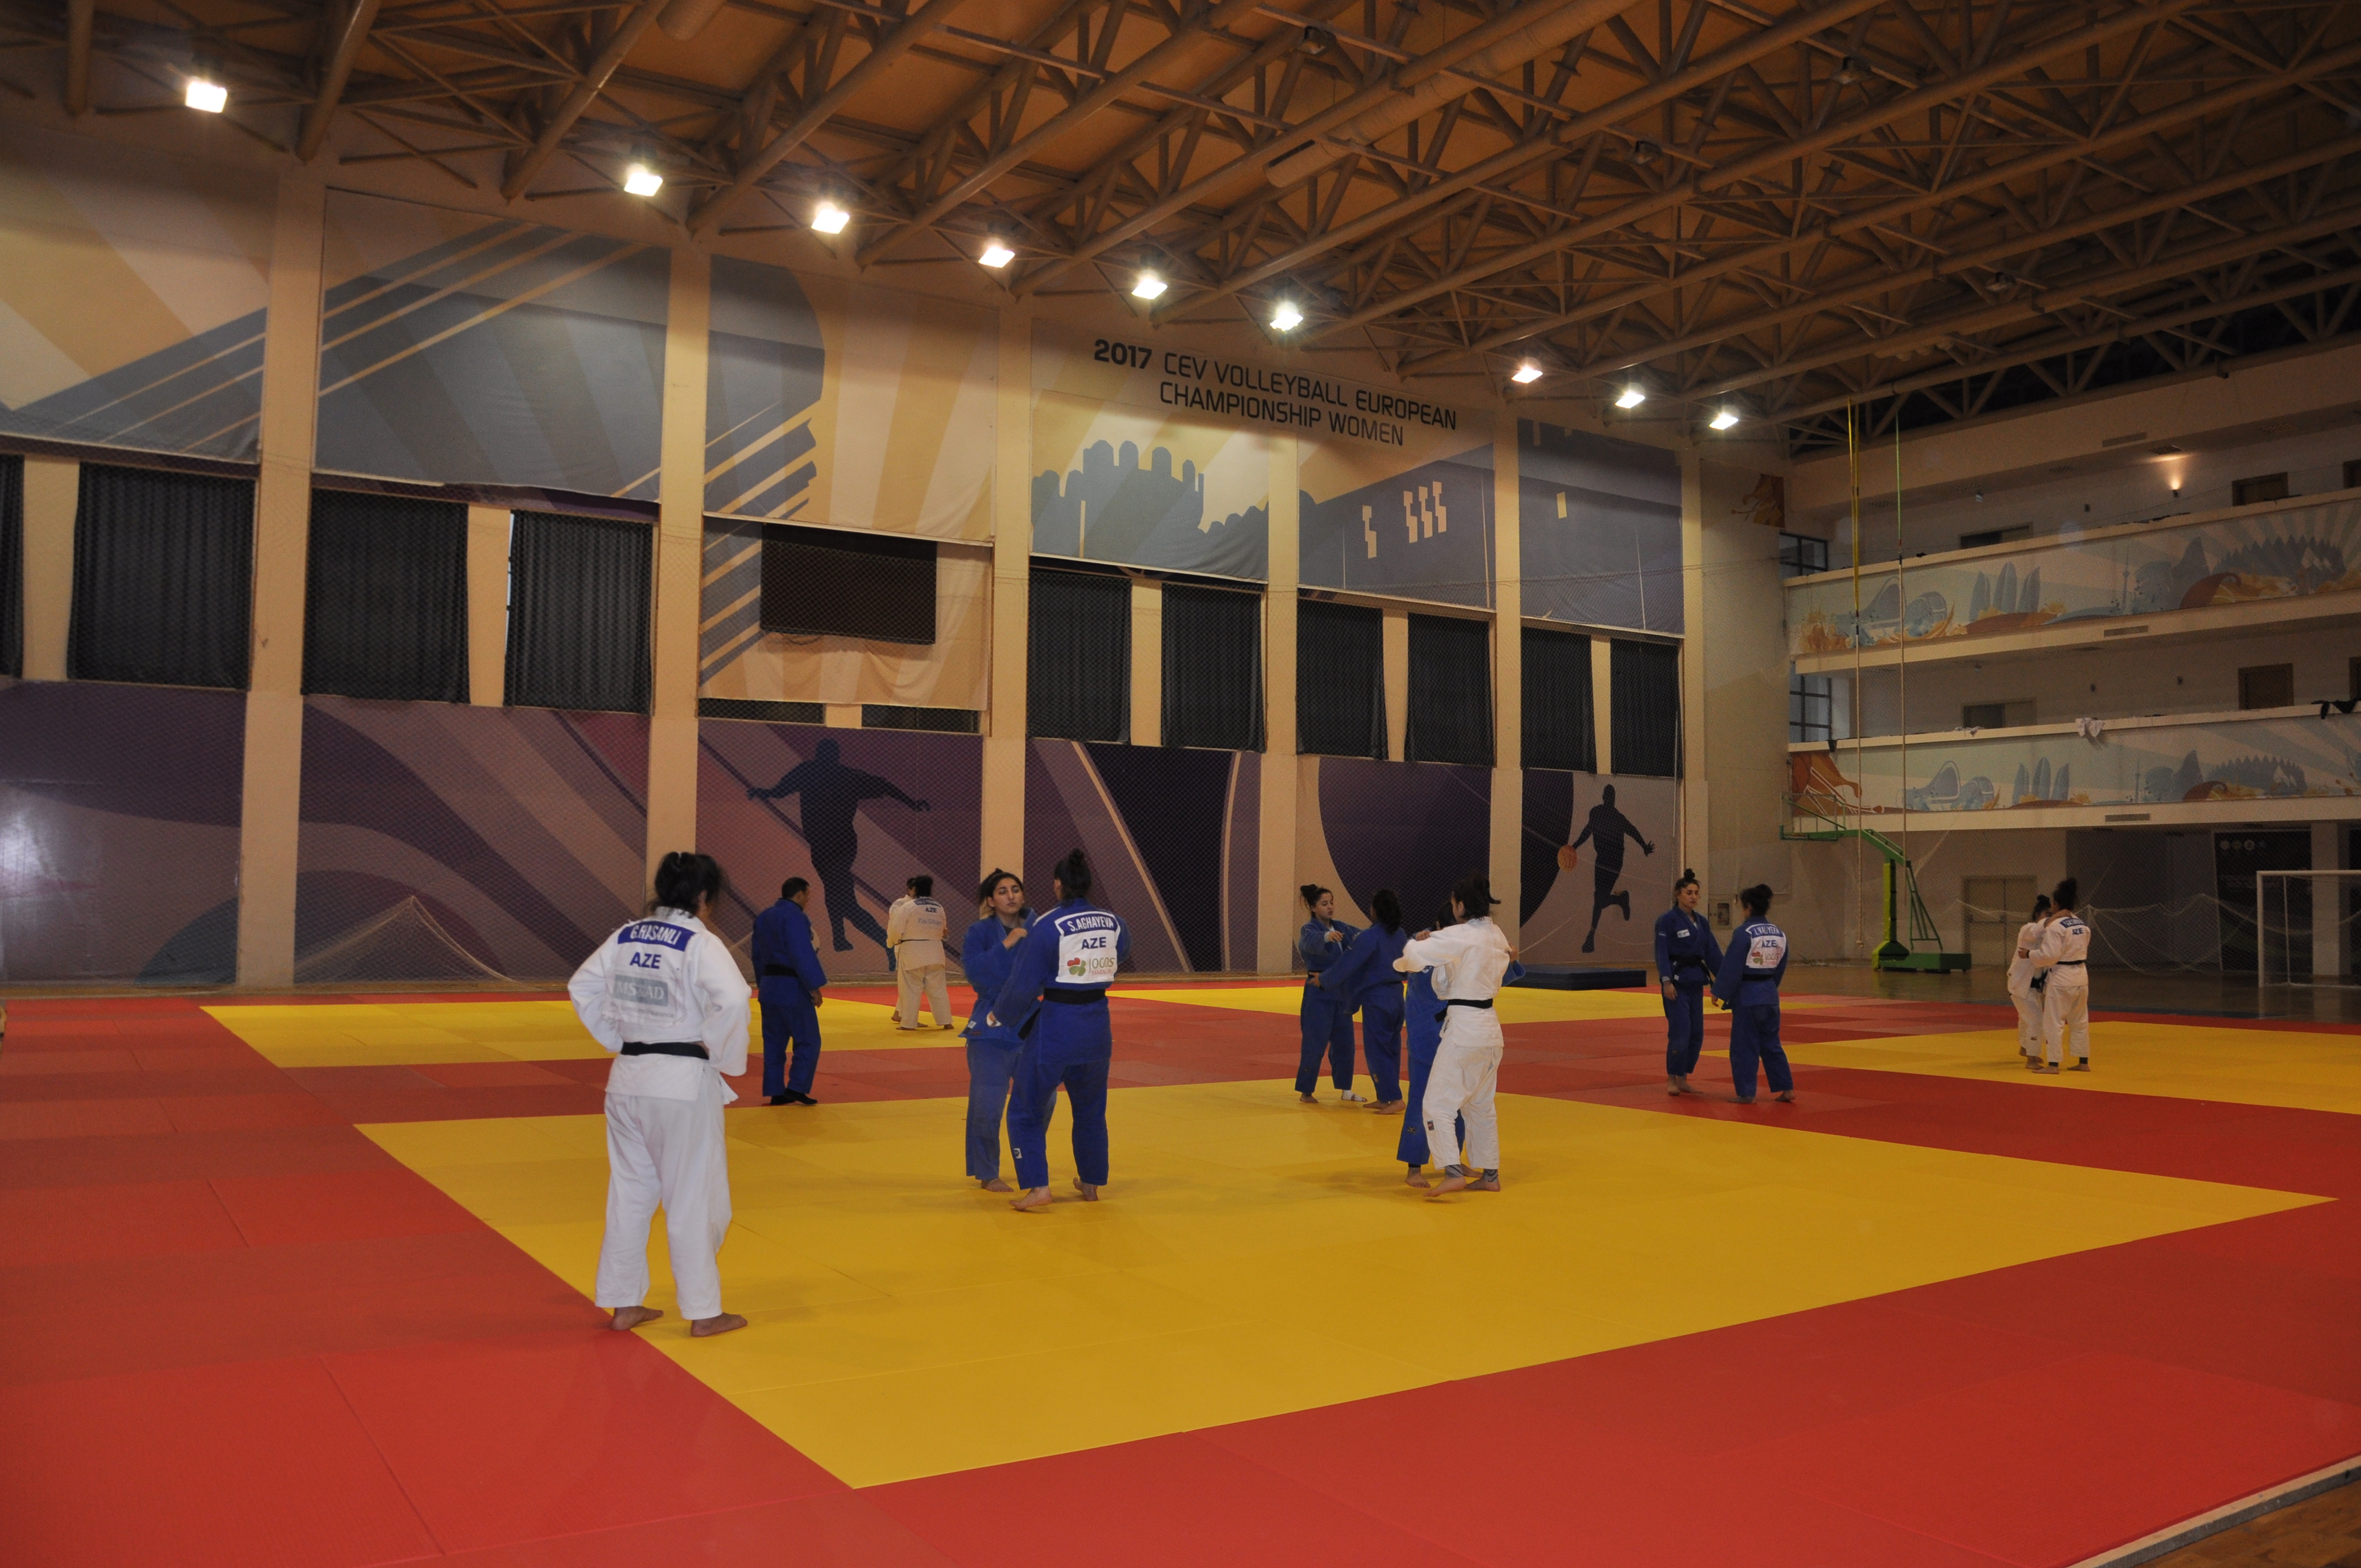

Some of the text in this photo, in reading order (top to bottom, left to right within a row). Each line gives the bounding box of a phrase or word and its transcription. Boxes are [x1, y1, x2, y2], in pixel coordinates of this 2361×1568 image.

[1094, 339, 1456, 430] 2017 CEV VOLLEYBALL EUROPEAN
[1160, 381, 1403, 446] CHAMPIONSHIP WOMEN
[629, 951, 661, 969] AZE
[1081, 937, 1107, 950] AZE
